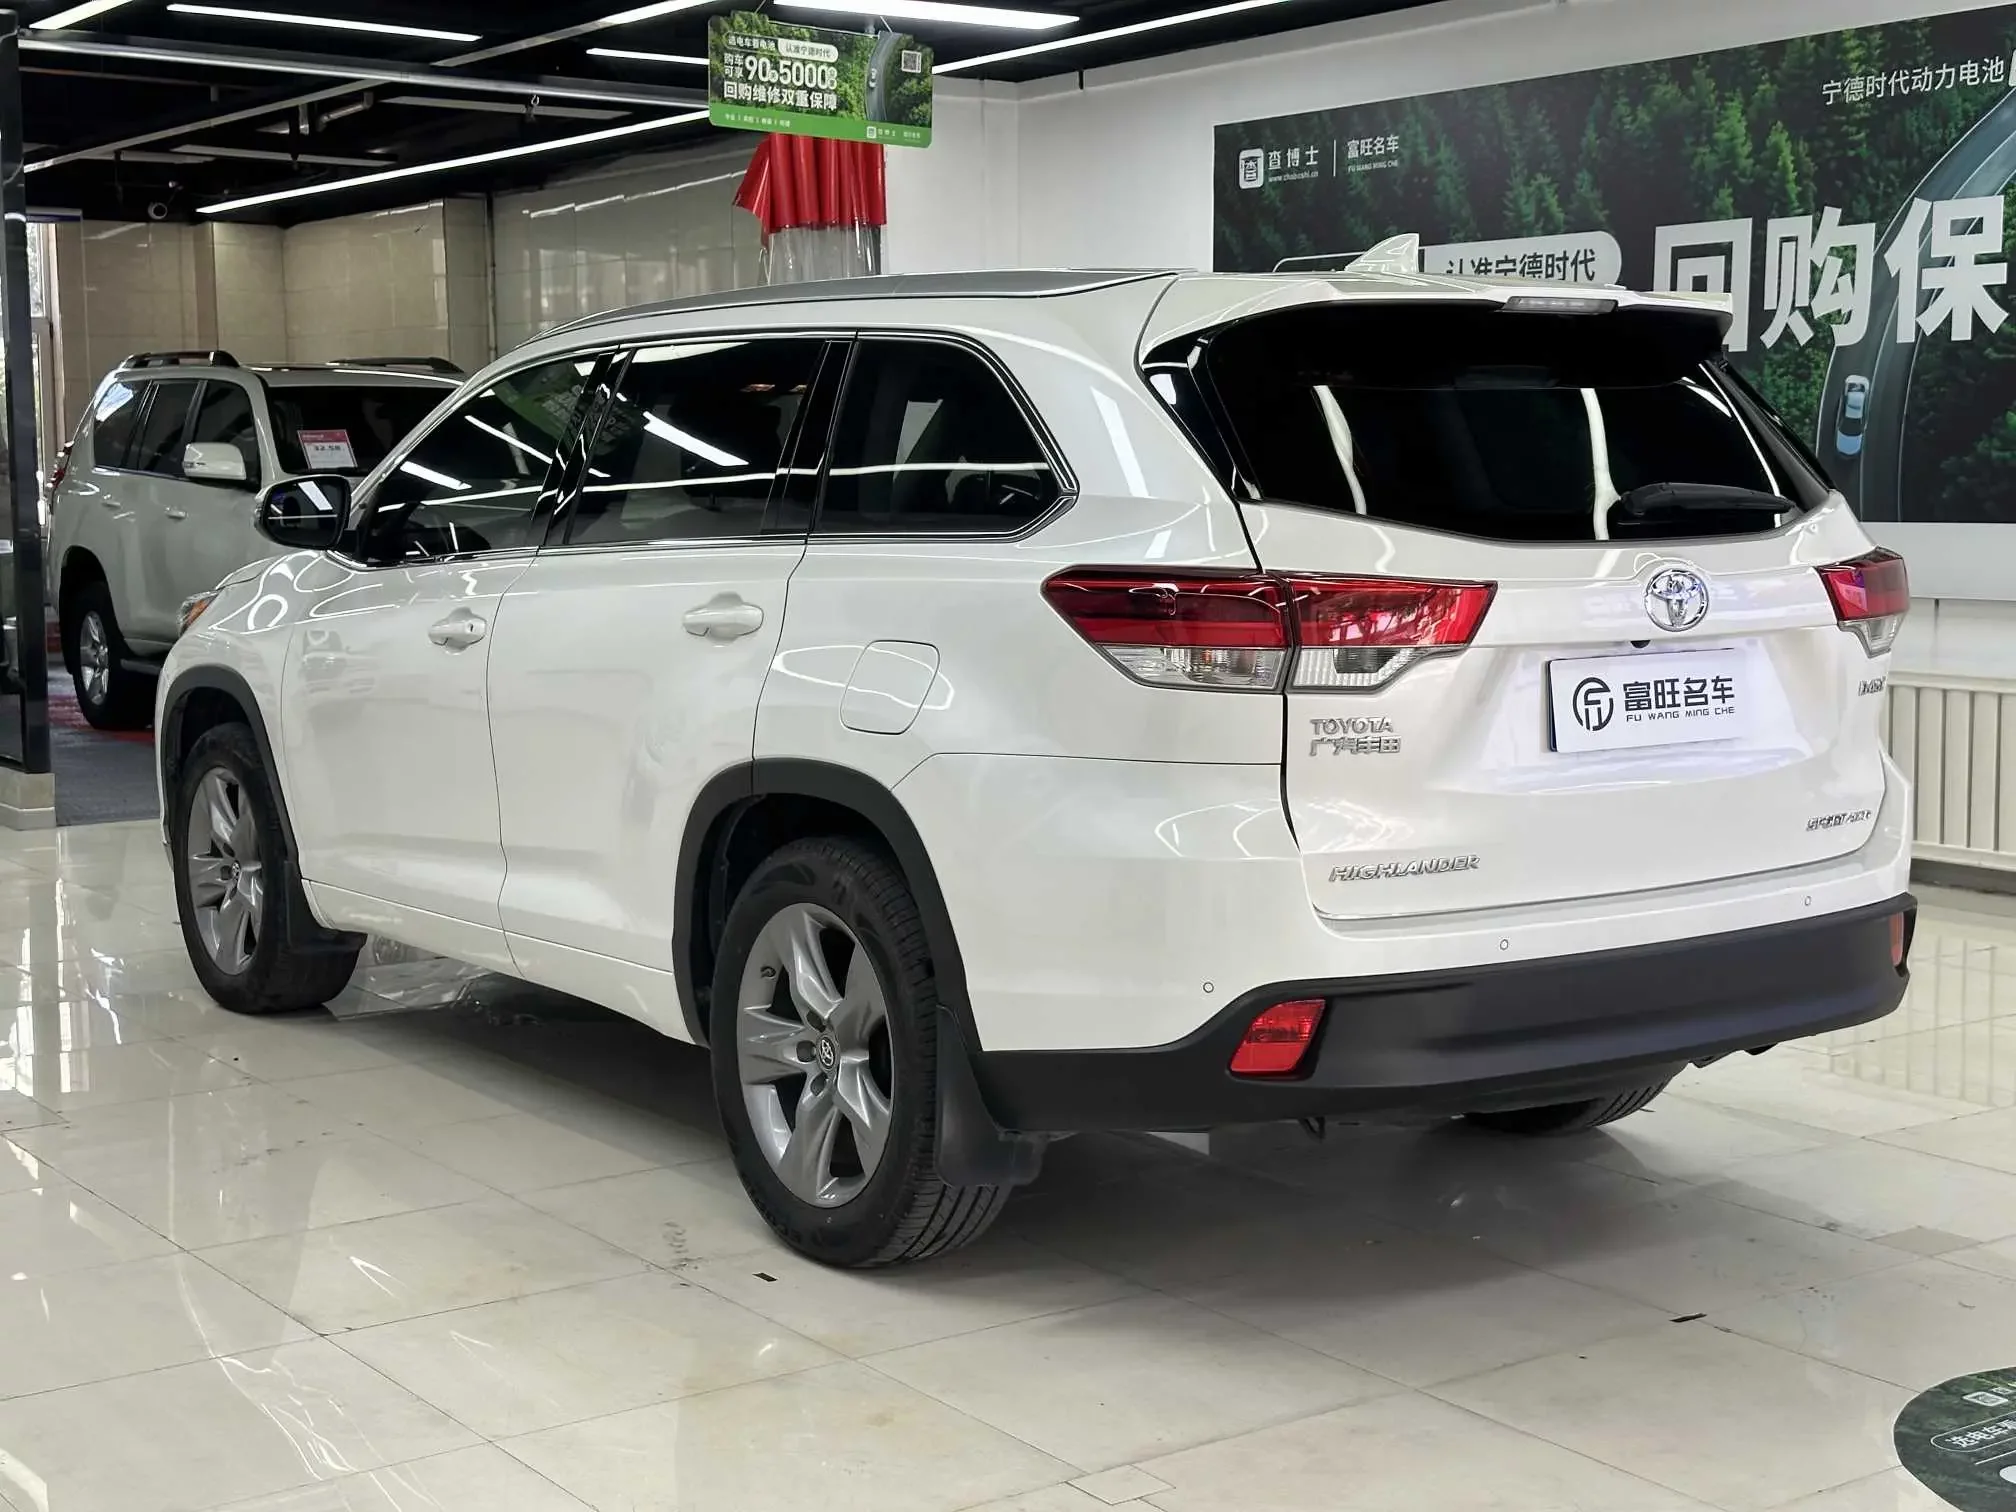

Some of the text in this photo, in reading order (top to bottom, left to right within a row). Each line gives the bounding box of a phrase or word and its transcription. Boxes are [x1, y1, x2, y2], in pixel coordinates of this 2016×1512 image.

[1821, 57, 2005, 105] 宁德时代动力电池
[723, 80, 838, 111] 回购维修双重保障
[1268, 145, 1319, 170] 查博士
[1347, 134, 1399, 159] 富旺名车
[1653, 195, 2010, 352] 回购保
[1622, 675, 1735, 712] 富旺名车
[1309, 717, 1394, 735] TOYOTA
[1626, 706, 1735, 723] FU WANG MING CHE
[1309, 736, 1401, 756] 广汽丰田
[1328, 854, 1481, 883] HIGHLANDER
